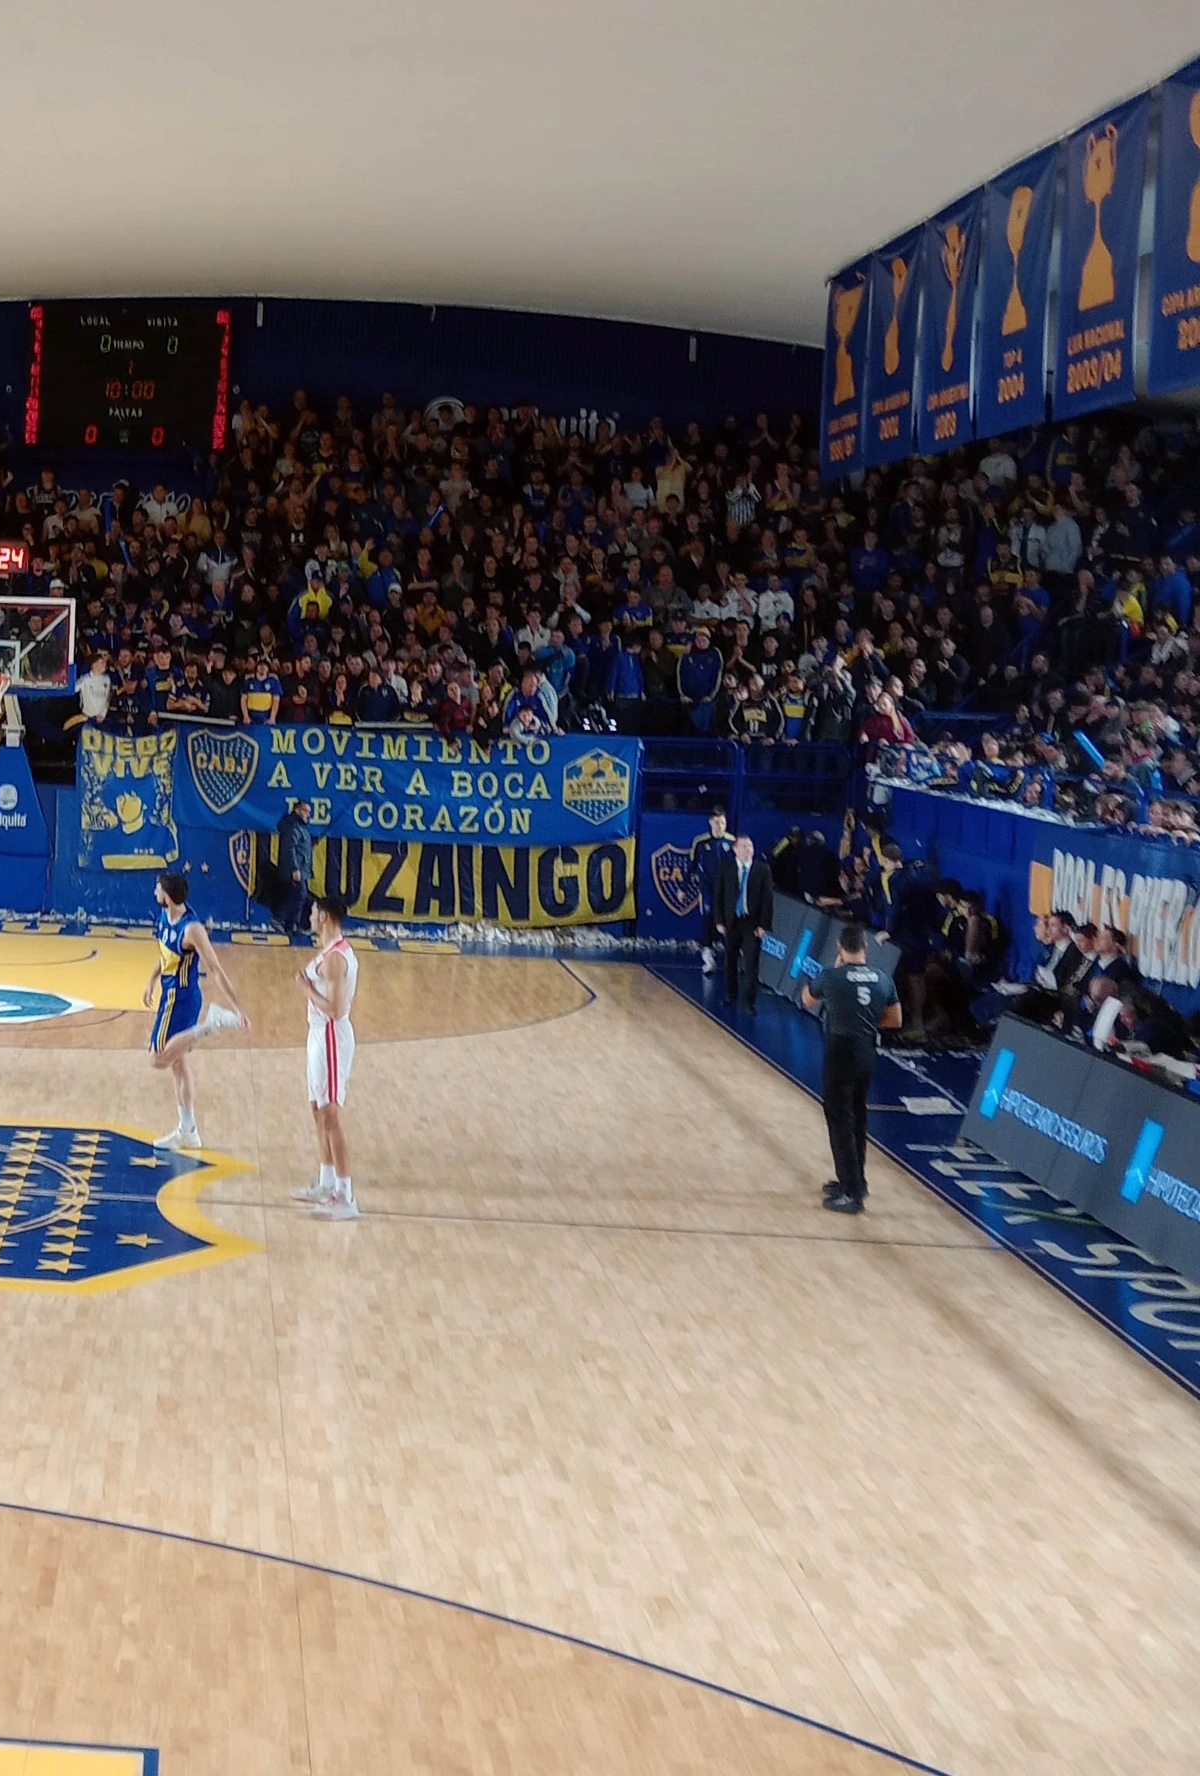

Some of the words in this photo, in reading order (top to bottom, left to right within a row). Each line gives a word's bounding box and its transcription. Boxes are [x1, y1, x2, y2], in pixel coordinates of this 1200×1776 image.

[80, 315, 111, 326] LOCAL
[105, 379, 156, 400] 10:00
[84, 423, 98, 445] 0
[151, 425, 165, 447] 0
[270, 727, 550, 766] MOVIMIENTO
[197, 753, 249, 775] CABJ
[267, 760, 291, 788] A
[311, 762, 386, 794] VER
[405, 768, 430, 796] A
[451, 769, 551, 800] BOCA
[353, 798, 533, 836] CORAZÓN
[322, 842, 638, 920] UZAINGO
